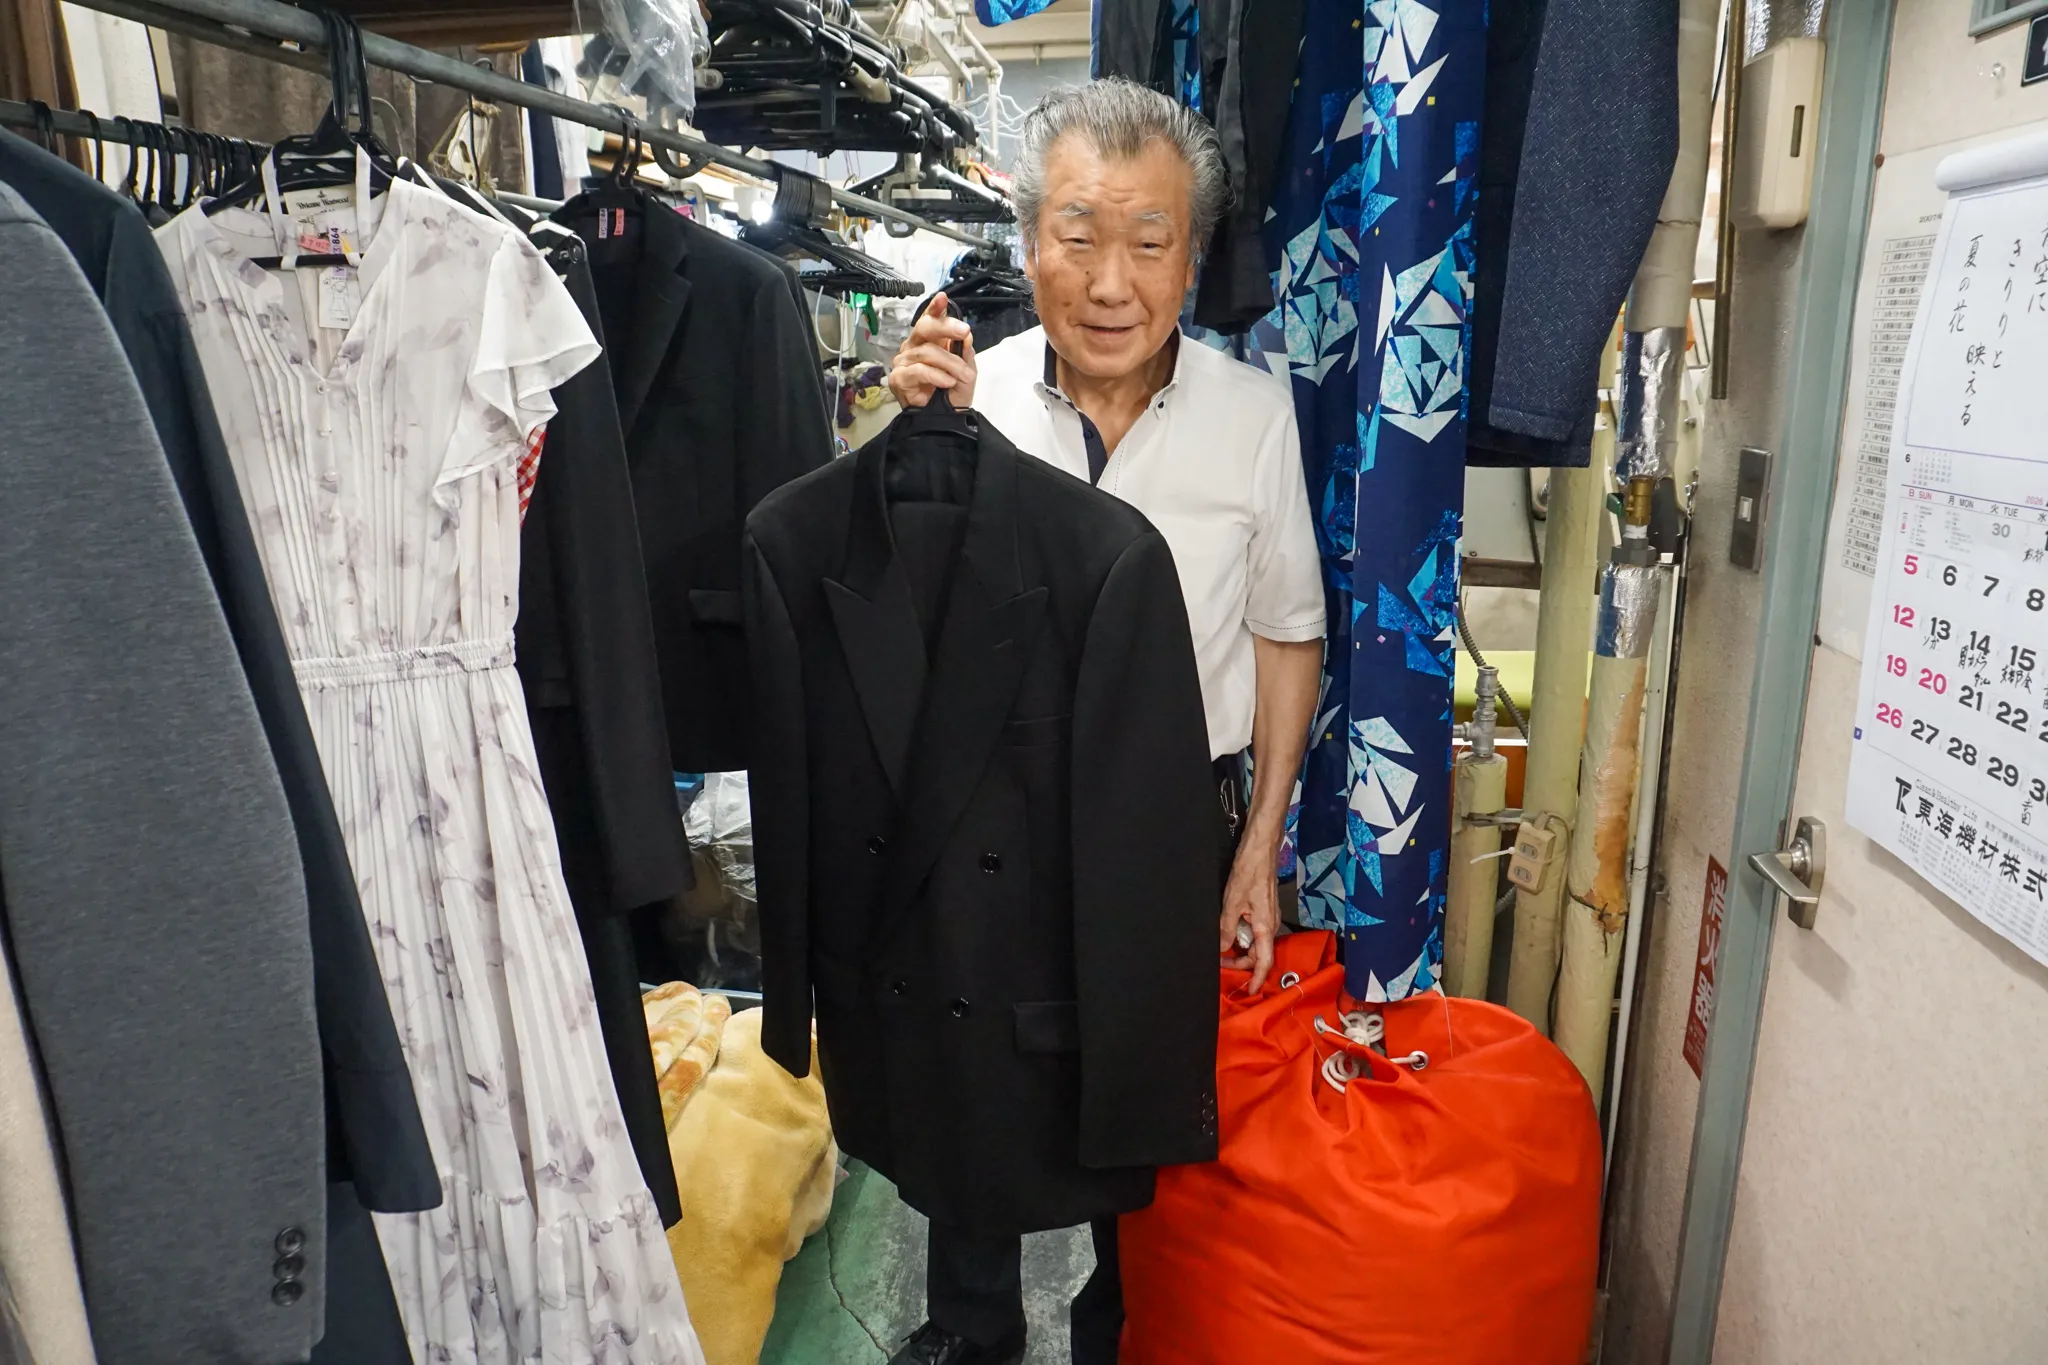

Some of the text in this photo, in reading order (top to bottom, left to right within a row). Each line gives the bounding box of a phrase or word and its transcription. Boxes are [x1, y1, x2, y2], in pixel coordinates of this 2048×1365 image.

[1949, 234, 1984, 333] 夏の花
[1992, 239, 2022, 368] きりりと
[1961, 344, 1986, 426] 映える
[1905, 453, 1911, 463] 6
[1908, 488, 2047, 522] 日 SUN 月 MON 火 TUE 水
[1992, 522, 2011, 538] 30
[1903, 555, 2045, 611] 5 6 7 8
[1893, 604, 2036, 672] 12 13 14 15
[1886, 654, 1907, 677] 19
[1918, 668, 1947, 694] 20
[1958, 685, 1983, 711] 21
[1995, 701, 2029, 732] 22
[1876, 703, 2048, 806] 26 27 28 29 3
[1915, 796, 2048, 902] 東海機材株式
